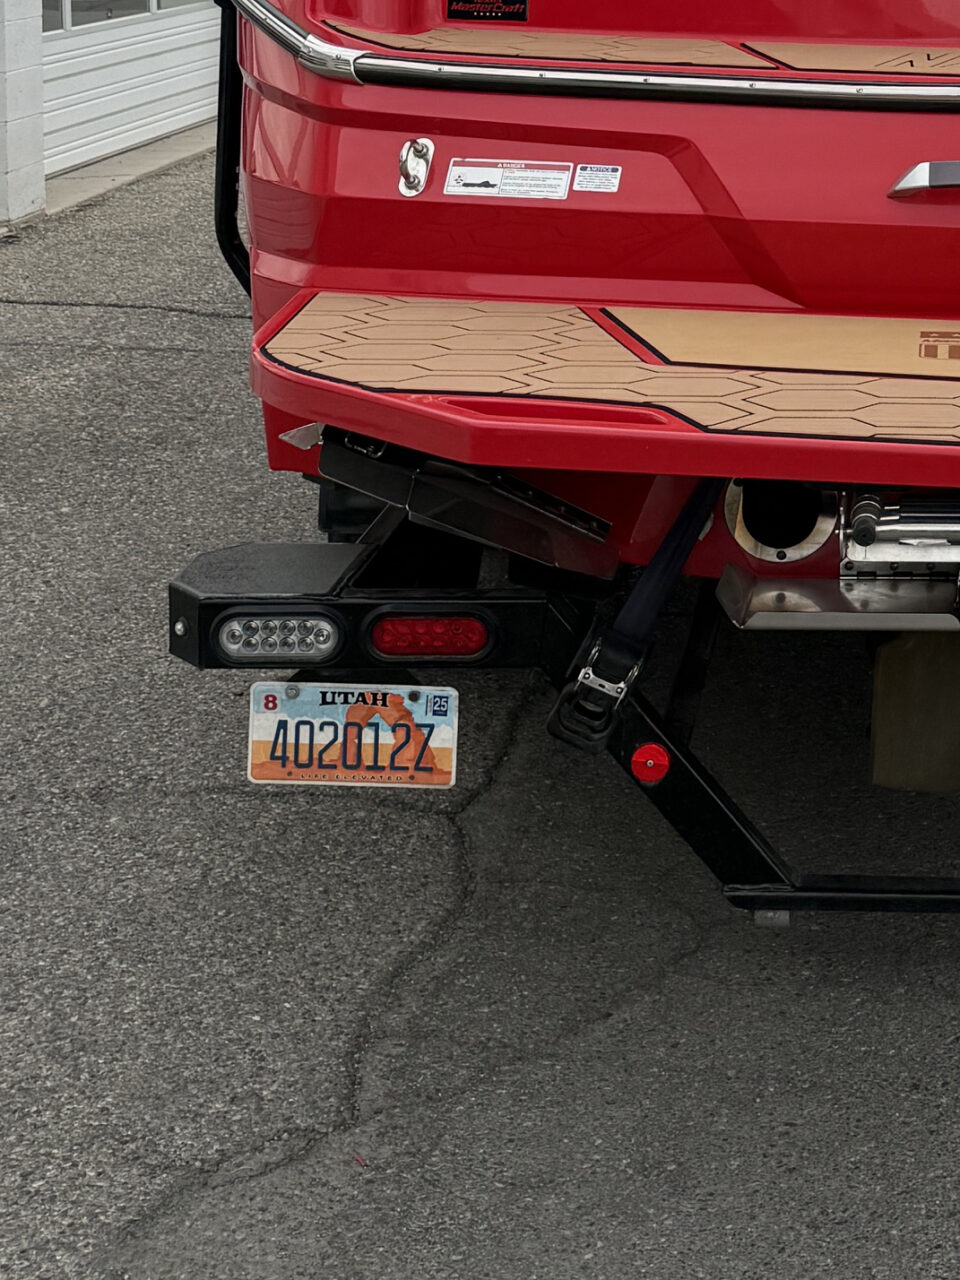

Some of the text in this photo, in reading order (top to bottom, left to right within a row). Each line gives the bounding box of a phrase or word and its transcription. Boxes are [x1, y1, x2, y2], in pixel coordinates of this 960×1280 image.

[263, 694, 278, 711] 8
[319, 690, 391, 708] UTAH
[433, 697, 448, 711] 25
[269, 719, 435, 773] 402012Z
